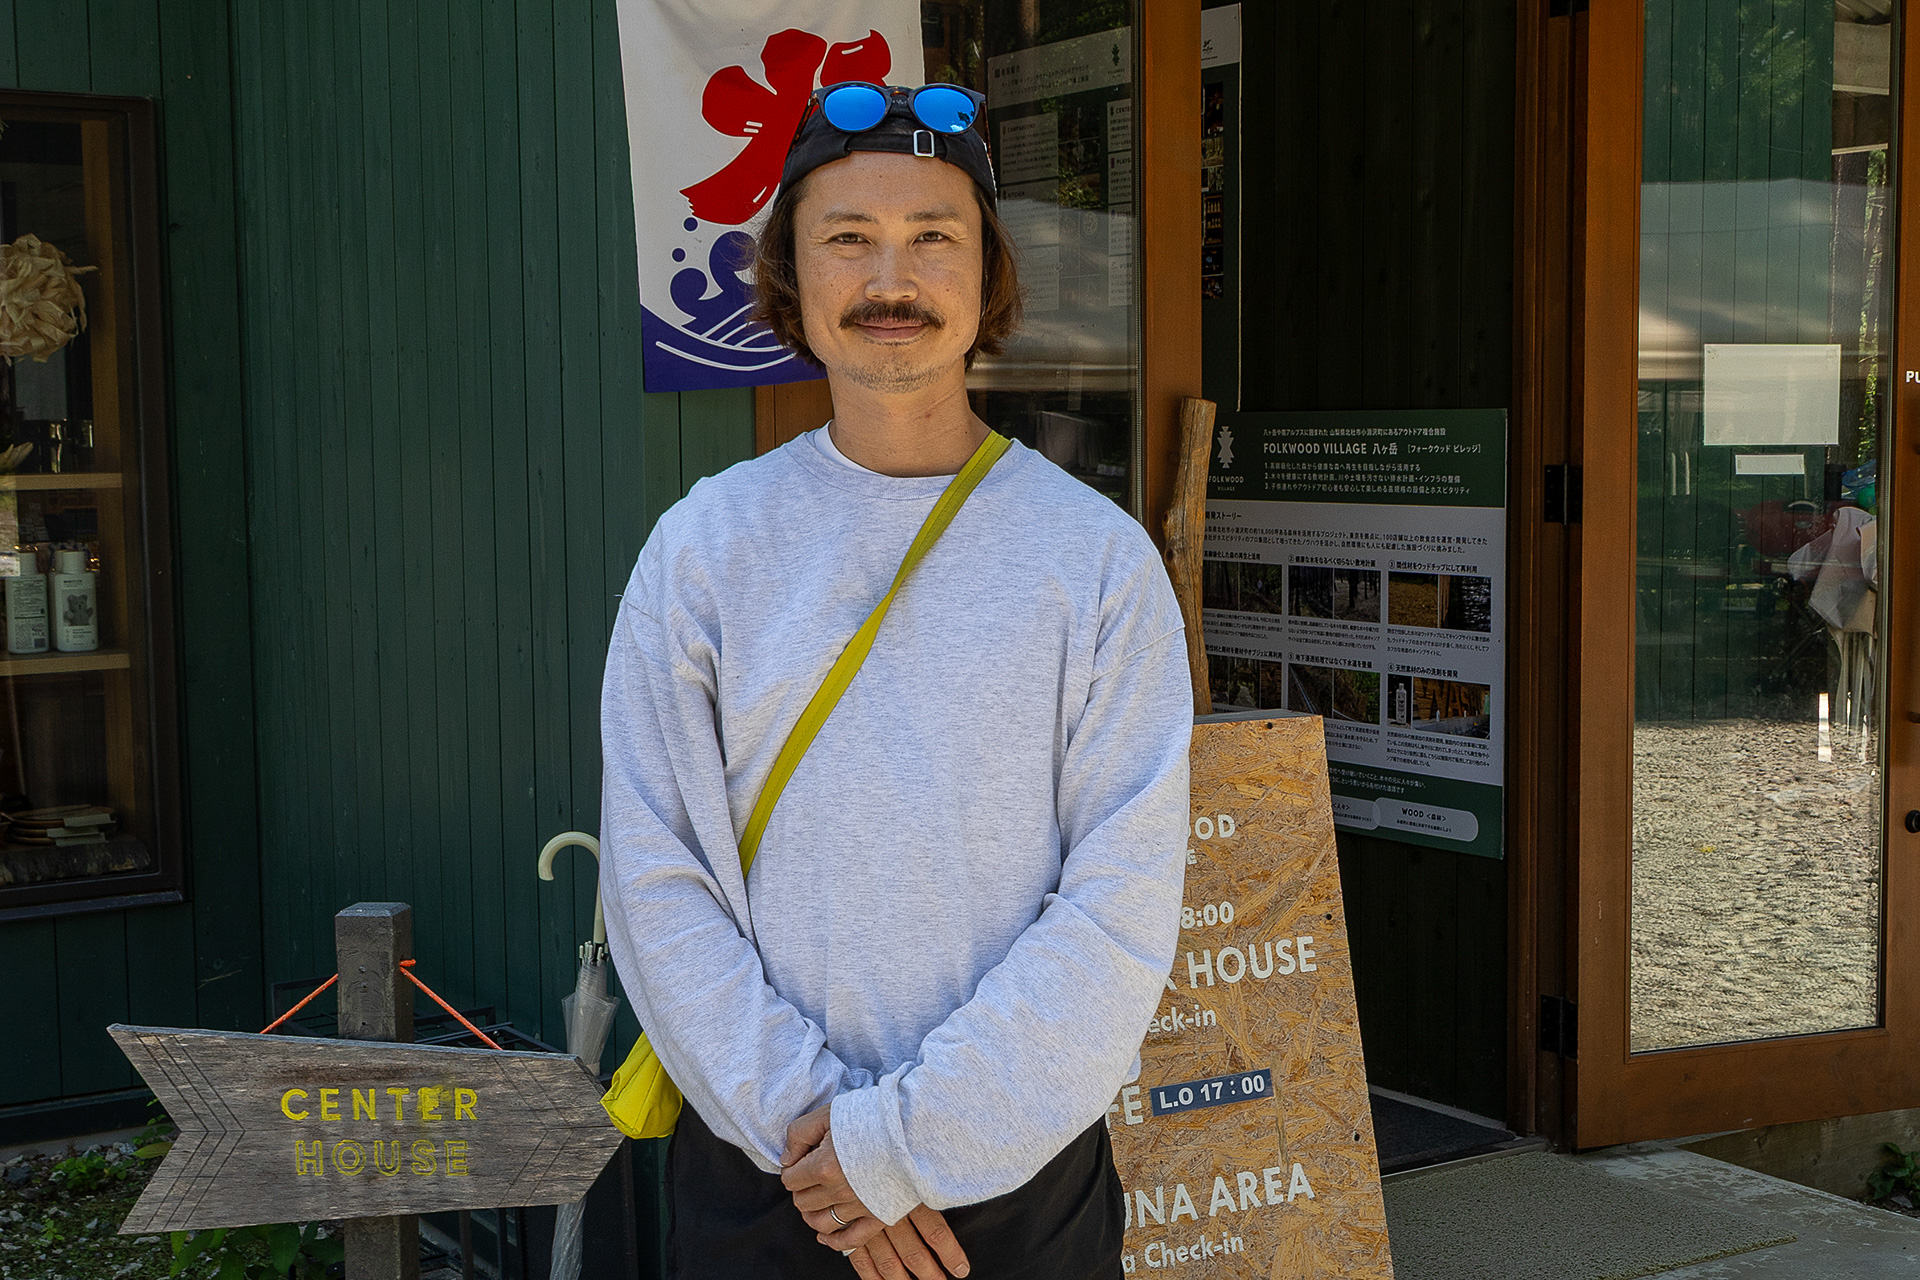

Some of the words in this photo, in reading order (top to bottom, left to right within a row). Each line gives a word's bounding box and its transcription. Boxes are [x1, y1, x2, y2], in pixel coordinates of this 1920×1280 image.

[1263, 443, 1320, 454] FOLKWOOD
[1323, 443, 1367, 454] VILLAGE
[1372, 442, 1398, 455] 八ヶ岳
[1208, 475, 1244, 484] FOLKWOOD
[1188, 814, 1235, 840] OD
[1401, 807, 1424, 818] WOOD
[1186, 936, 1318, 989] HOUSE
[280, 1086, 479, 1122] CENTER
[1159, 1087, 1194, 1109] L.O
[294, 1137, 470, 1178] HOUSE
[1208, 1162, 1315, 1217] AREA
[1144, 1231, 1245, 1269] Check-in
